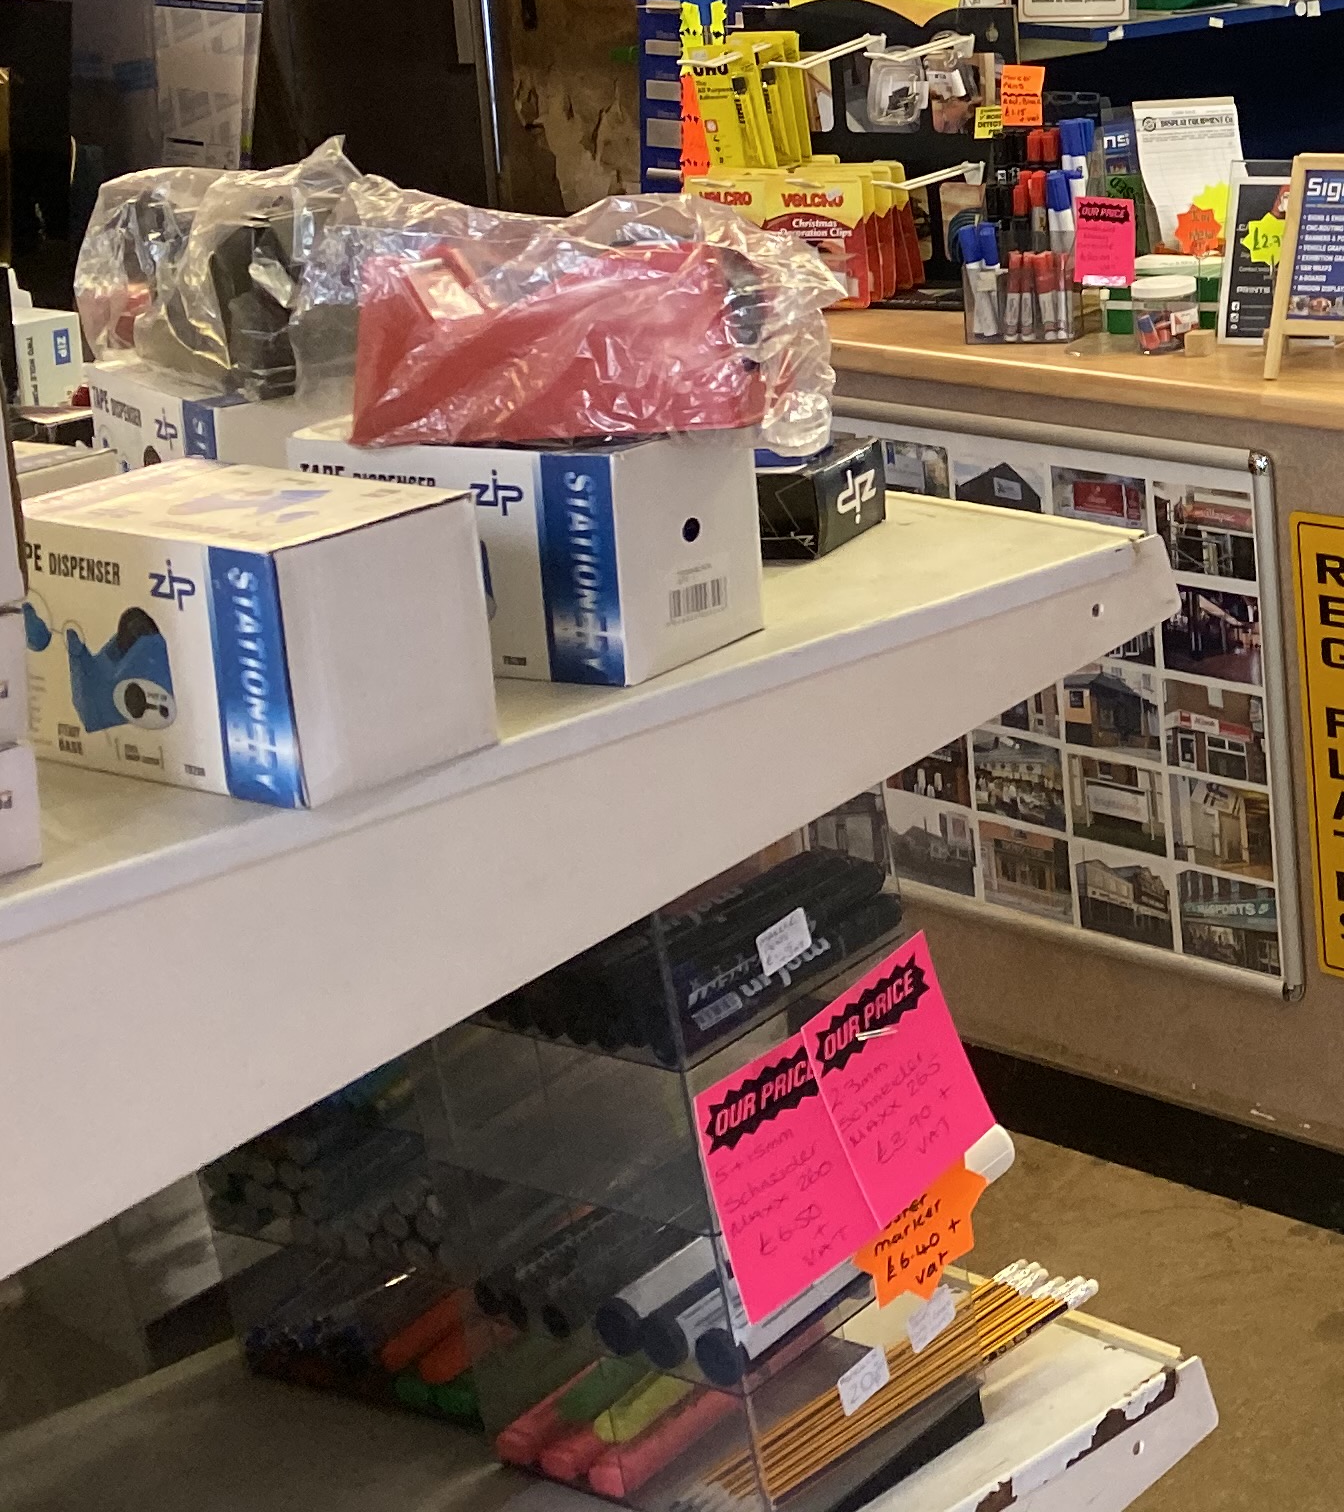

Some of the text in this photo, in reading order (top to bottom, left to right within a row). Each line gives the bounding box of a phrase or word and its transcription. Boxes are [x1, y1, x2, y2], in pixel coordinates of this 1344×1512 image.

[792, 218, 838, 228] Christmas
[828, 228, 853, 239] Clips
[1081, 206, 1127, 219] OUR PRICE
[56, 335, 68, 358] ZIP
[470, 469, 523, 516] zip
[48, 551, 121, 586] DISPENSER
[148, 559, 196, 611] zip
[564, 470, 611, 671] STATIONERY
[227, 566, 282, 795] STATIONERY
[823, 968, 915, 1061] OUR PRICE
[714, 1096, 755, 1137] OUR
[760, 1059, 816, 1110] PRICE
[874, 1199, 943, 1258] marker
